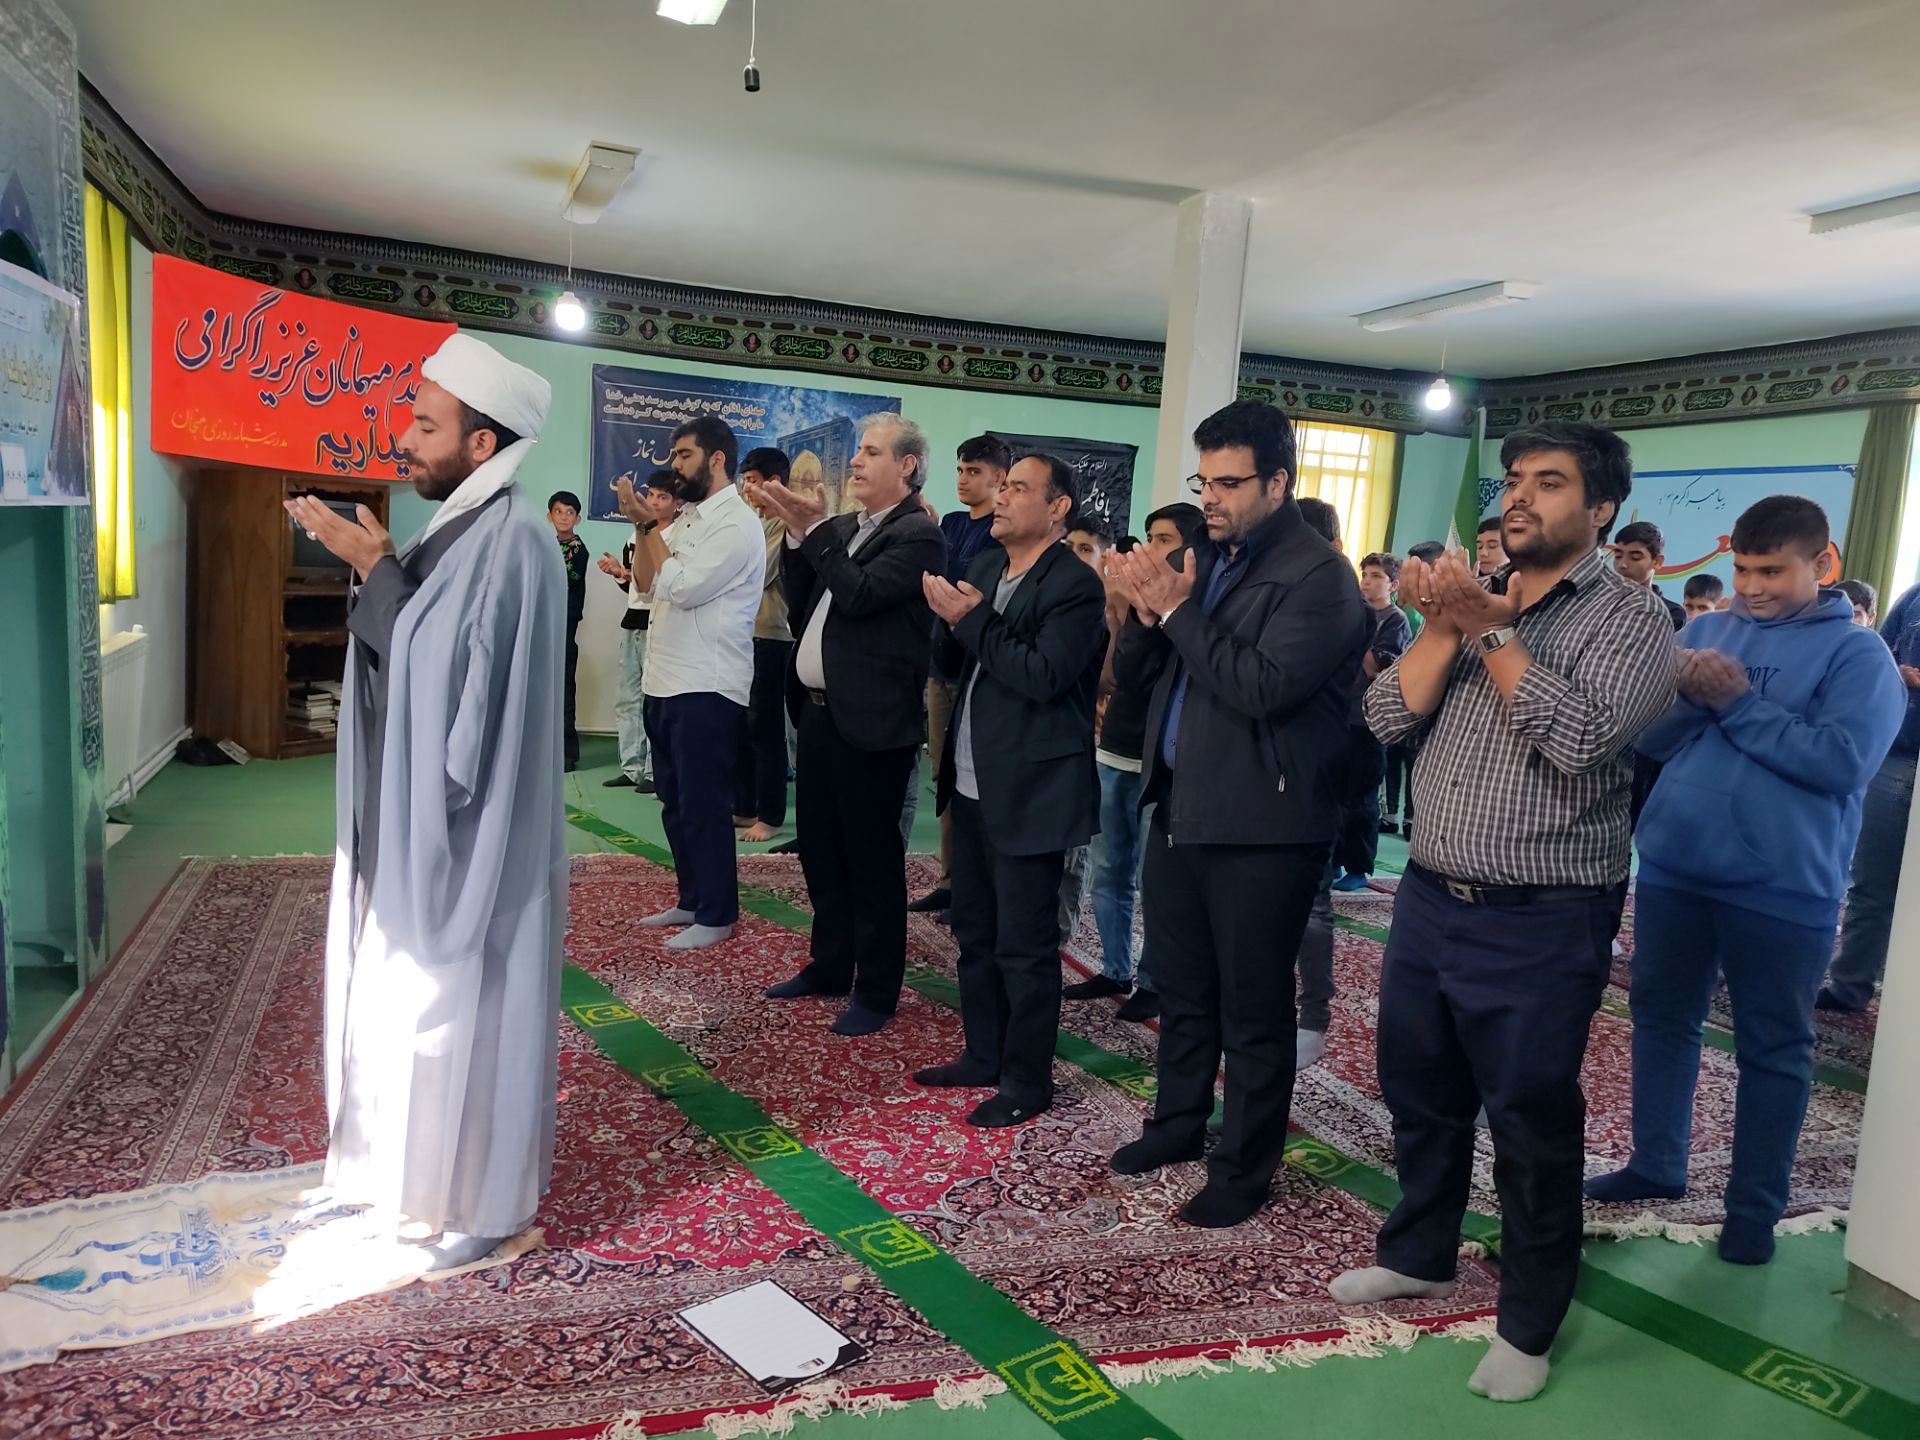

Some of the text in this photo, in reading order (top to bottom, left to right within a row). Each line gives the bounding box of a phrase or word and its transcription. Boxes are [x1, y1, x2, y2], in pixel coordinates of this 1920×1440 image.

[174, 289, 285, 370] گرامی
[605, 388, 624, 400] خدا
[623, 393, 646, 406] یعنی
[644, 394, 664, 409] رسد
[663, 399, 680, 409] می
[678, 398, 702, 412] گوش
[603, 403, 622, 415] است
[619, 406, 653, 419] کرده
[651, 409, 677, 422] دعوت
[721, 402, 742, 416] اذان
[740, 404, 766, 418] صدای
[202, 419, 233, 442] روزی
[631, 438, 656, 460] نماز
[1102, 498, 1111, 523] یا
